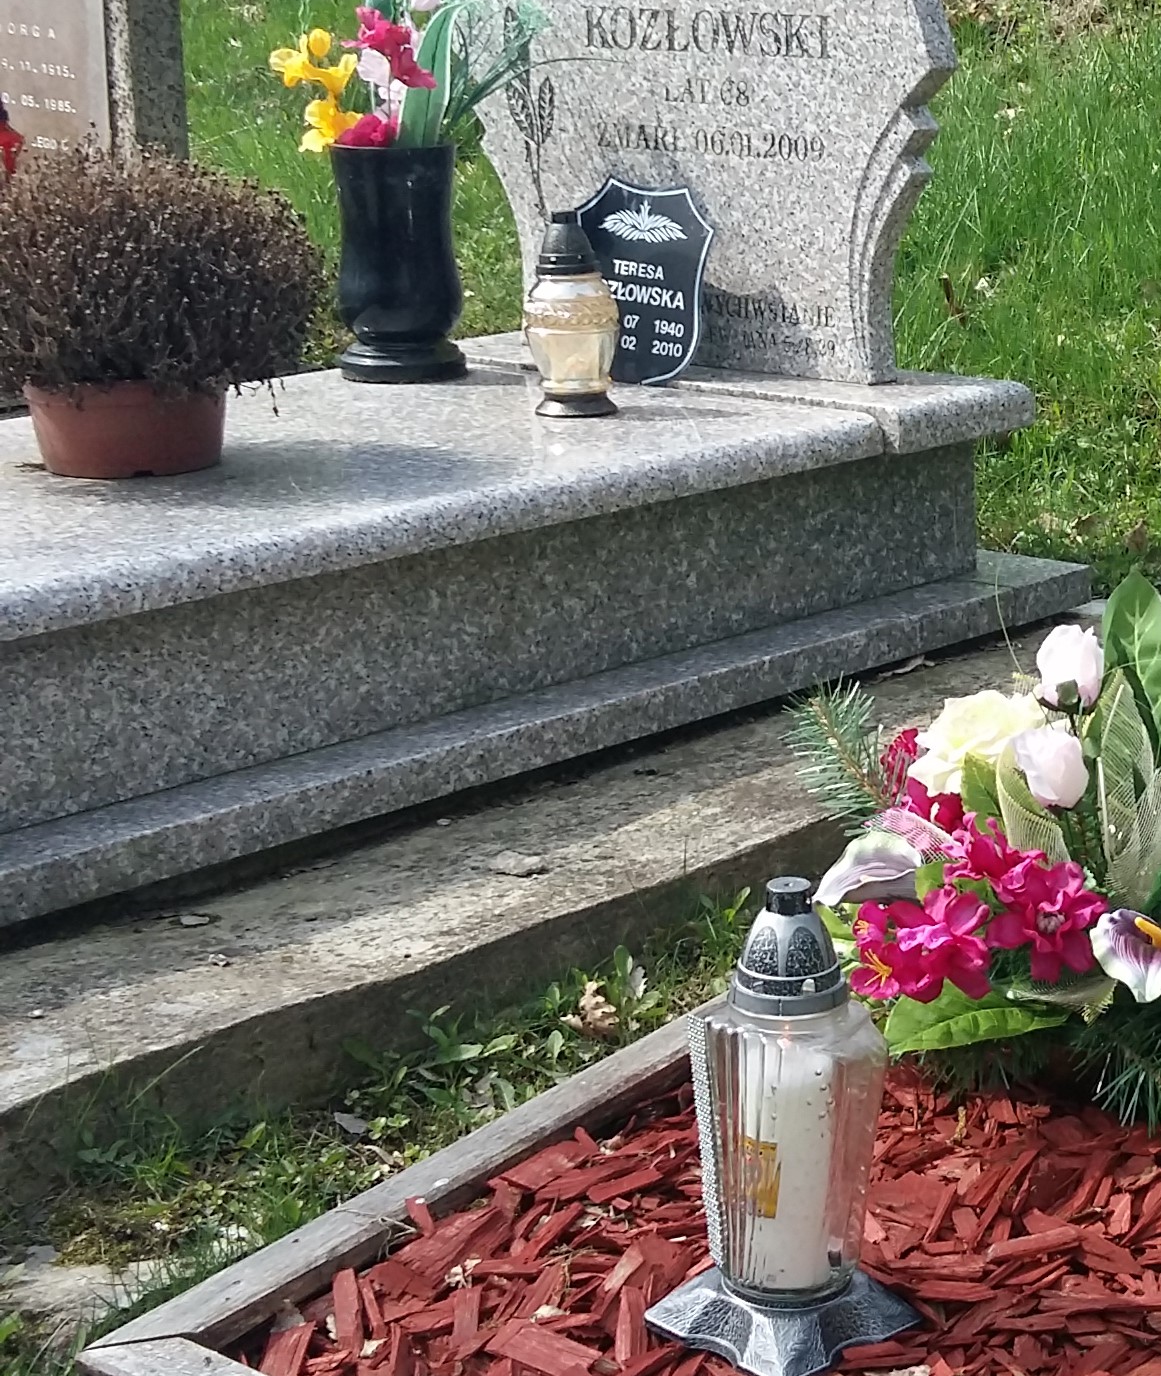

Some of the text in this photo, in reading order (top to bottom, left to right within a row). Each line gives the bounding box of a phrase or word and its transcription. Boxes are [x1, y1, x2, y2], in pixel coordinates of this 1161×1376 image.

[0, 22, 56, 39] ORGA
[582, 5, 832, 59] KOZŁOWSKI
[665, 78, 710, 104] LAT
[613, 259, 664, 280] TERESA
[602, 278, 684, 310] ZŁOWSKA
[623, 314, 684, 338] 07 1940
[621, 335, 683, 357] 02 2010
